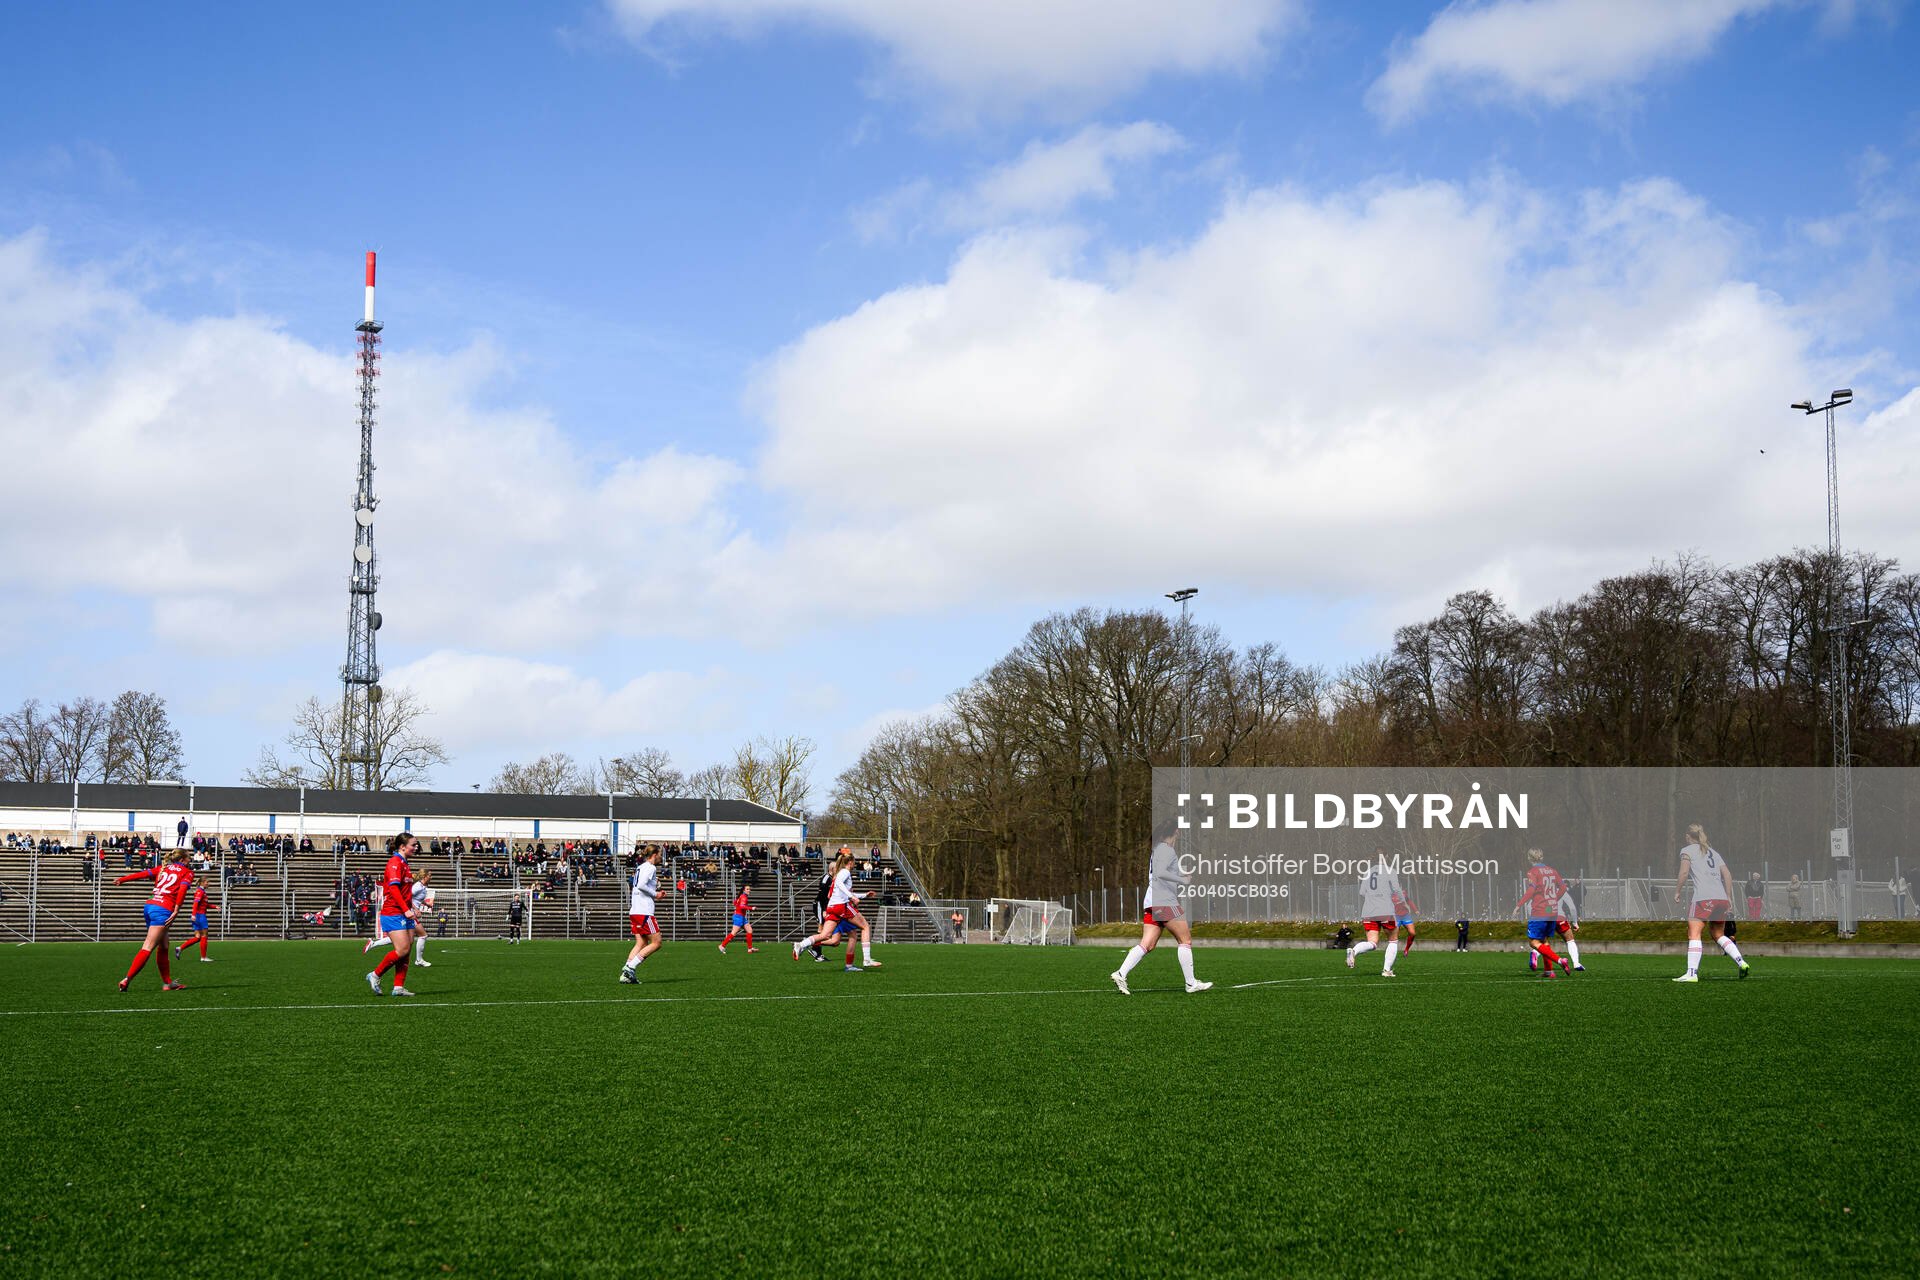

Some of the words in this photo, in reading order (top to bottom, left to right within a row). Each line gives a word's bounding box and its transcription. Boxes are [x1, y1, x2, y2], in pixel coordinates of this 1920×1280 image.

[1706, 849, 1715, 869] 3
[153, 871, 178, 894] 22
[1370, 871, 1379, 891] 6
[1542, 875, 1558, 900] 25
